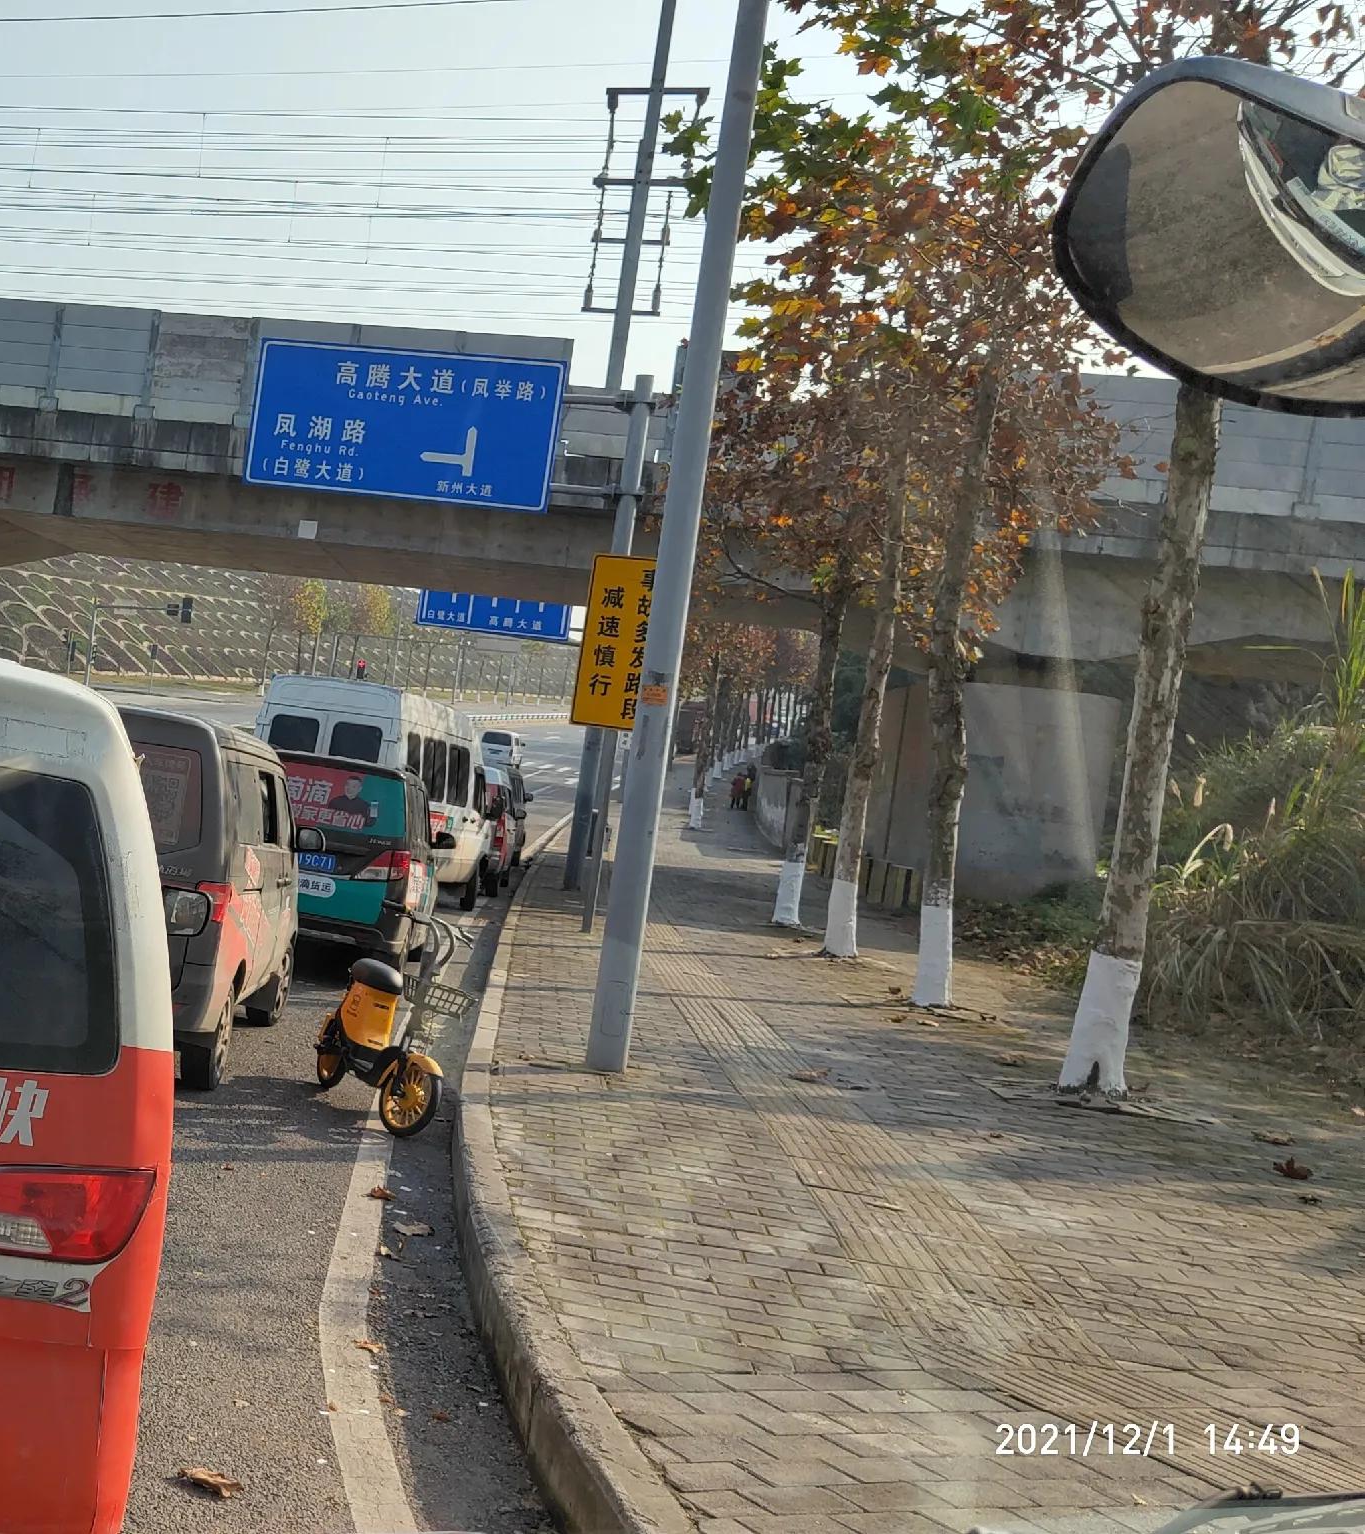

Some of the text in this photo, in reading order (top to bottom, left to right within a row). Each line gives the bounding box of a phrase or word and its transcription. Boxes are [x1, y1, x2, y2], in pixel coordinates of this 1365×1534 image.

[348, 388, 443, 407] Gaoteng Ave.
[274, 414, 367, 445] 凤湖路
[280, 440, 359, 459] Fenghu Rd.
[588, 586, 626, 697] 减速慎行
[298, 877, 332, 893] 滴货运
